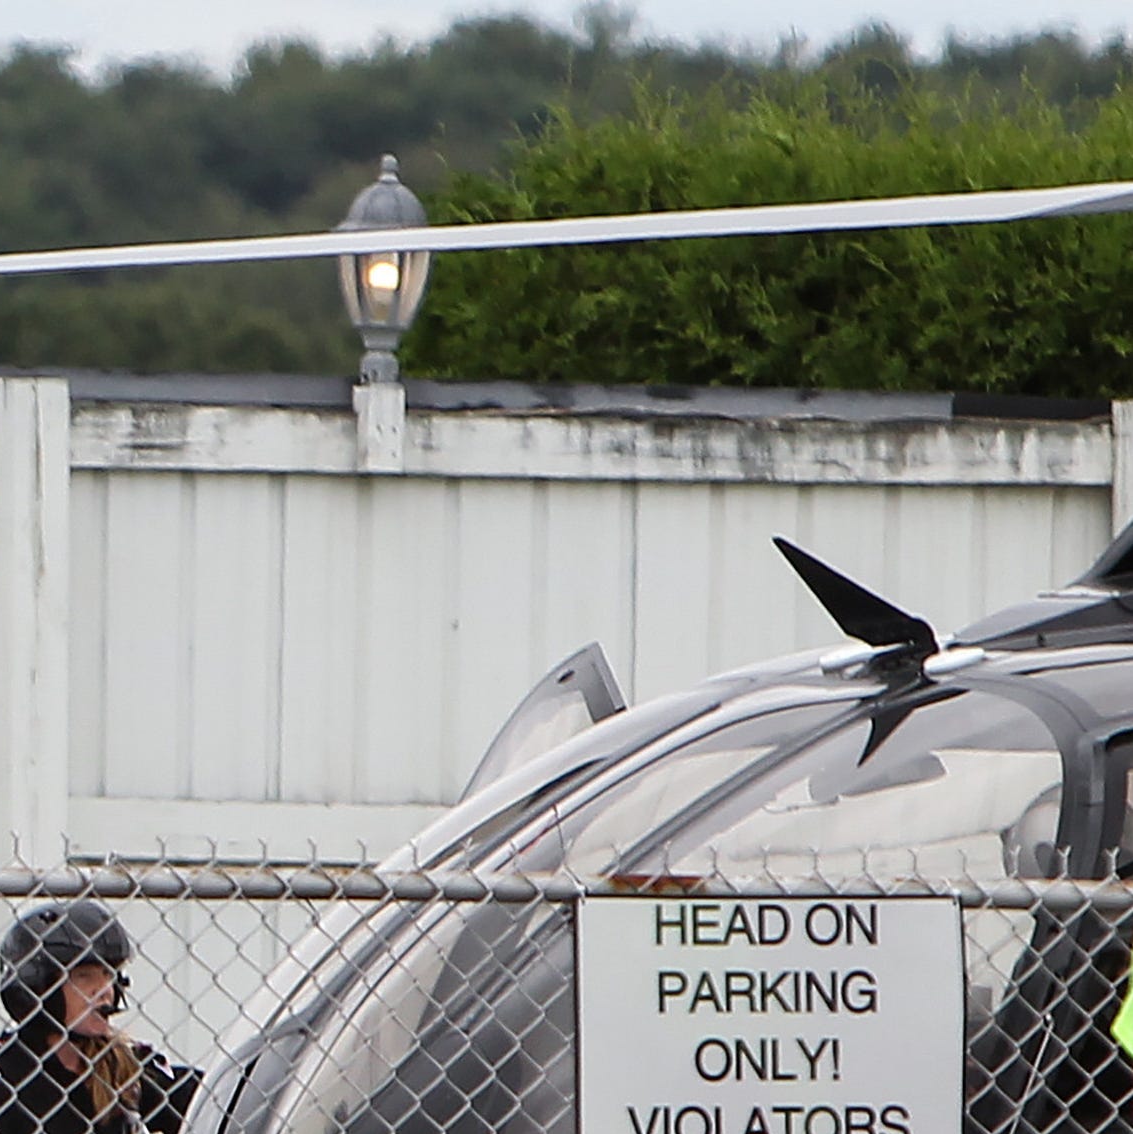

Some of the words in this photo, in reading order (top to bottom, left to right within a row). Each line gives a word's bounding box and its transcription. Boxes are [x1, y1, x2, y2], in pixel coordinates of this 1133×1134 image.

[655, 904, 791, 946] HEAD
[804, 903, 878, 946] ON
[658, 970, 877, 1014] PARKING
[694, 1038, 840, 1082] ONLY!
